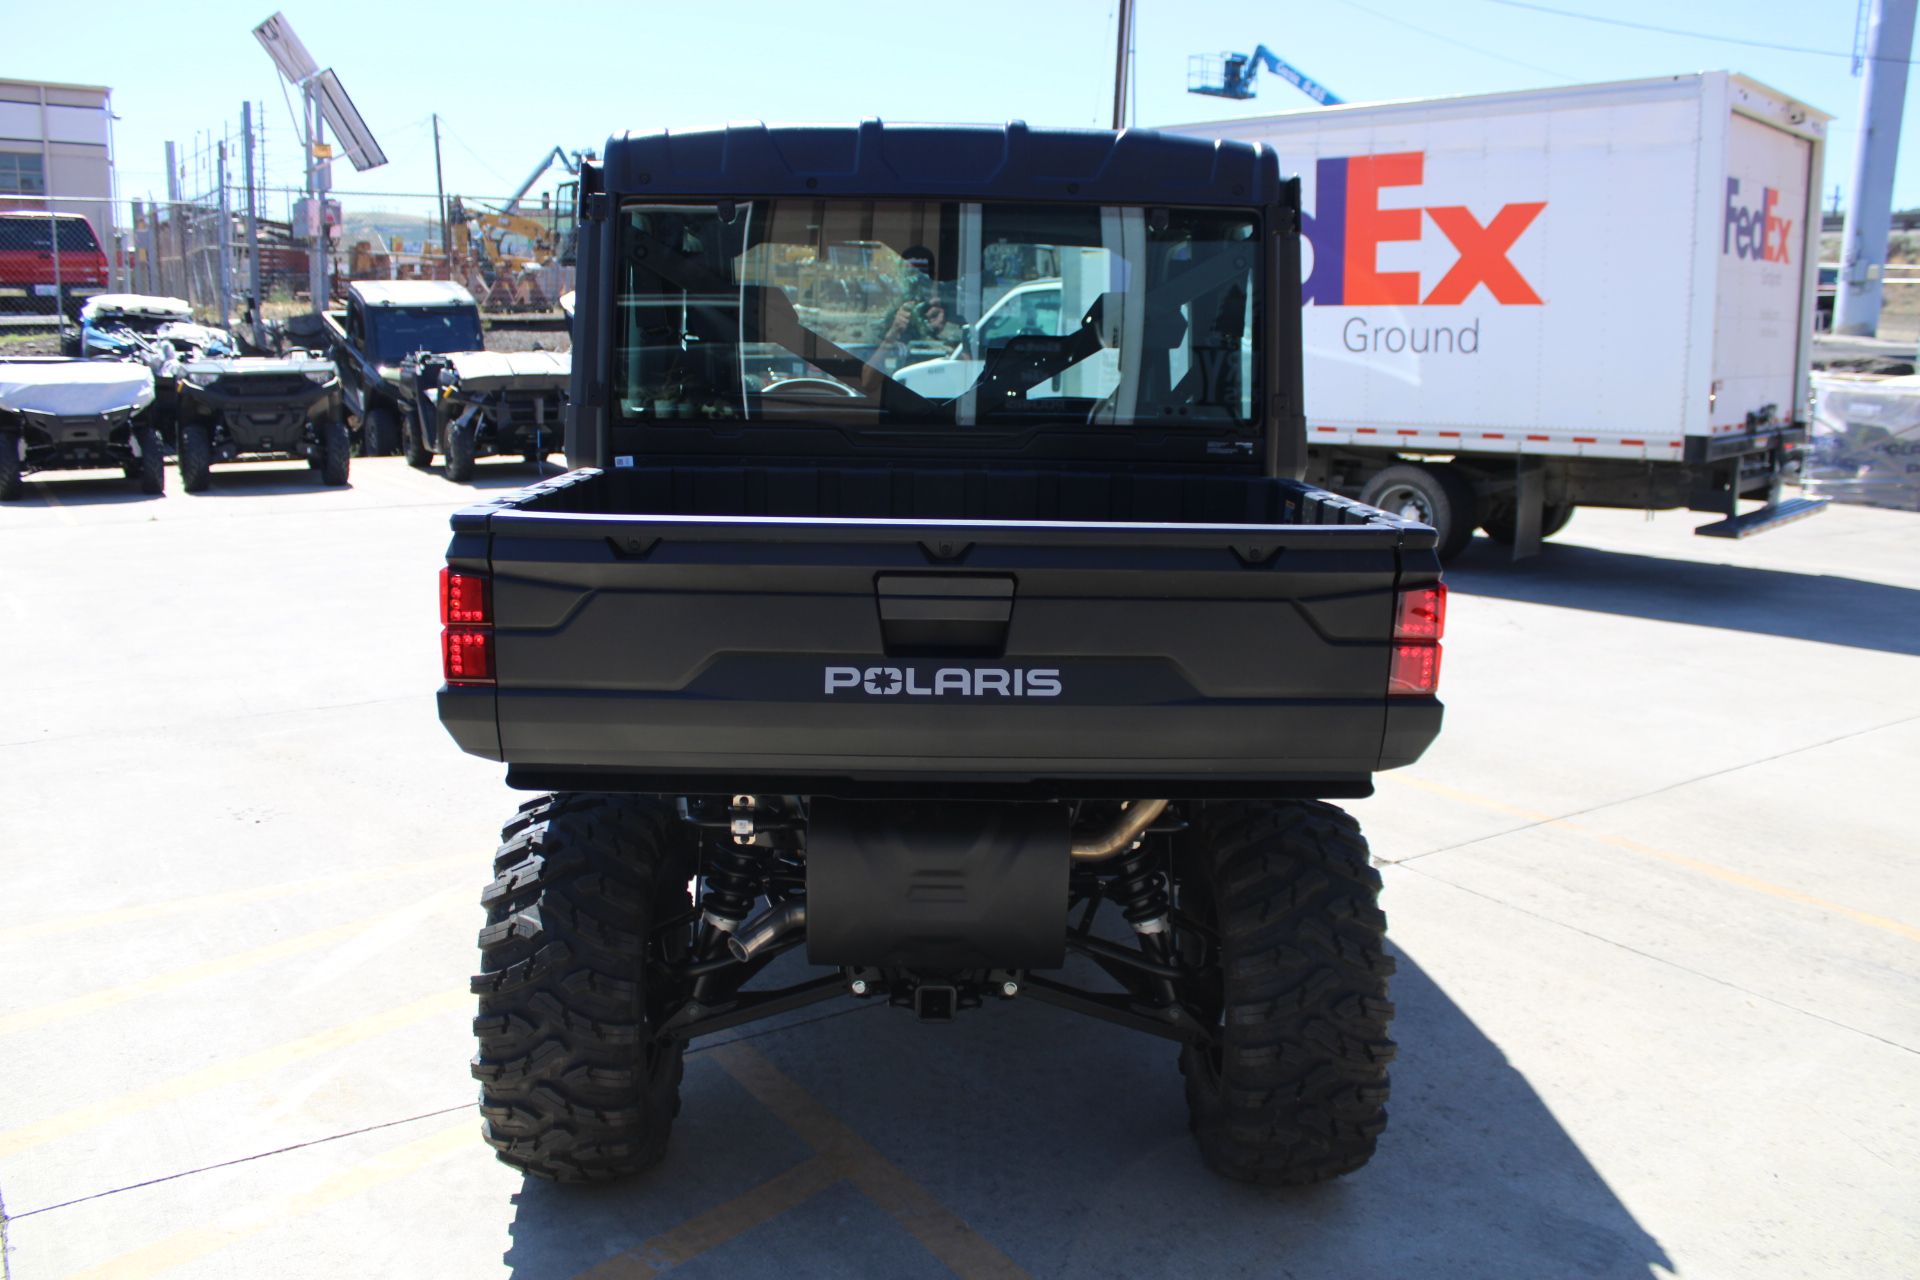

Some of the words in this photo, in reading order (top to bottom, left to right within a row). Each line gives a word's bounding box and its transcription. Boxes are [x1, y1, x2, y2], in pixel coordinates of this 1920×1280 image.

[1300, 151, 1548, 306] dEx
[1723, 177, 1792, 265] FedEx
[1343, 317, 1479, 354] Ground
[824, 666, 1062, 697] POLARIS
